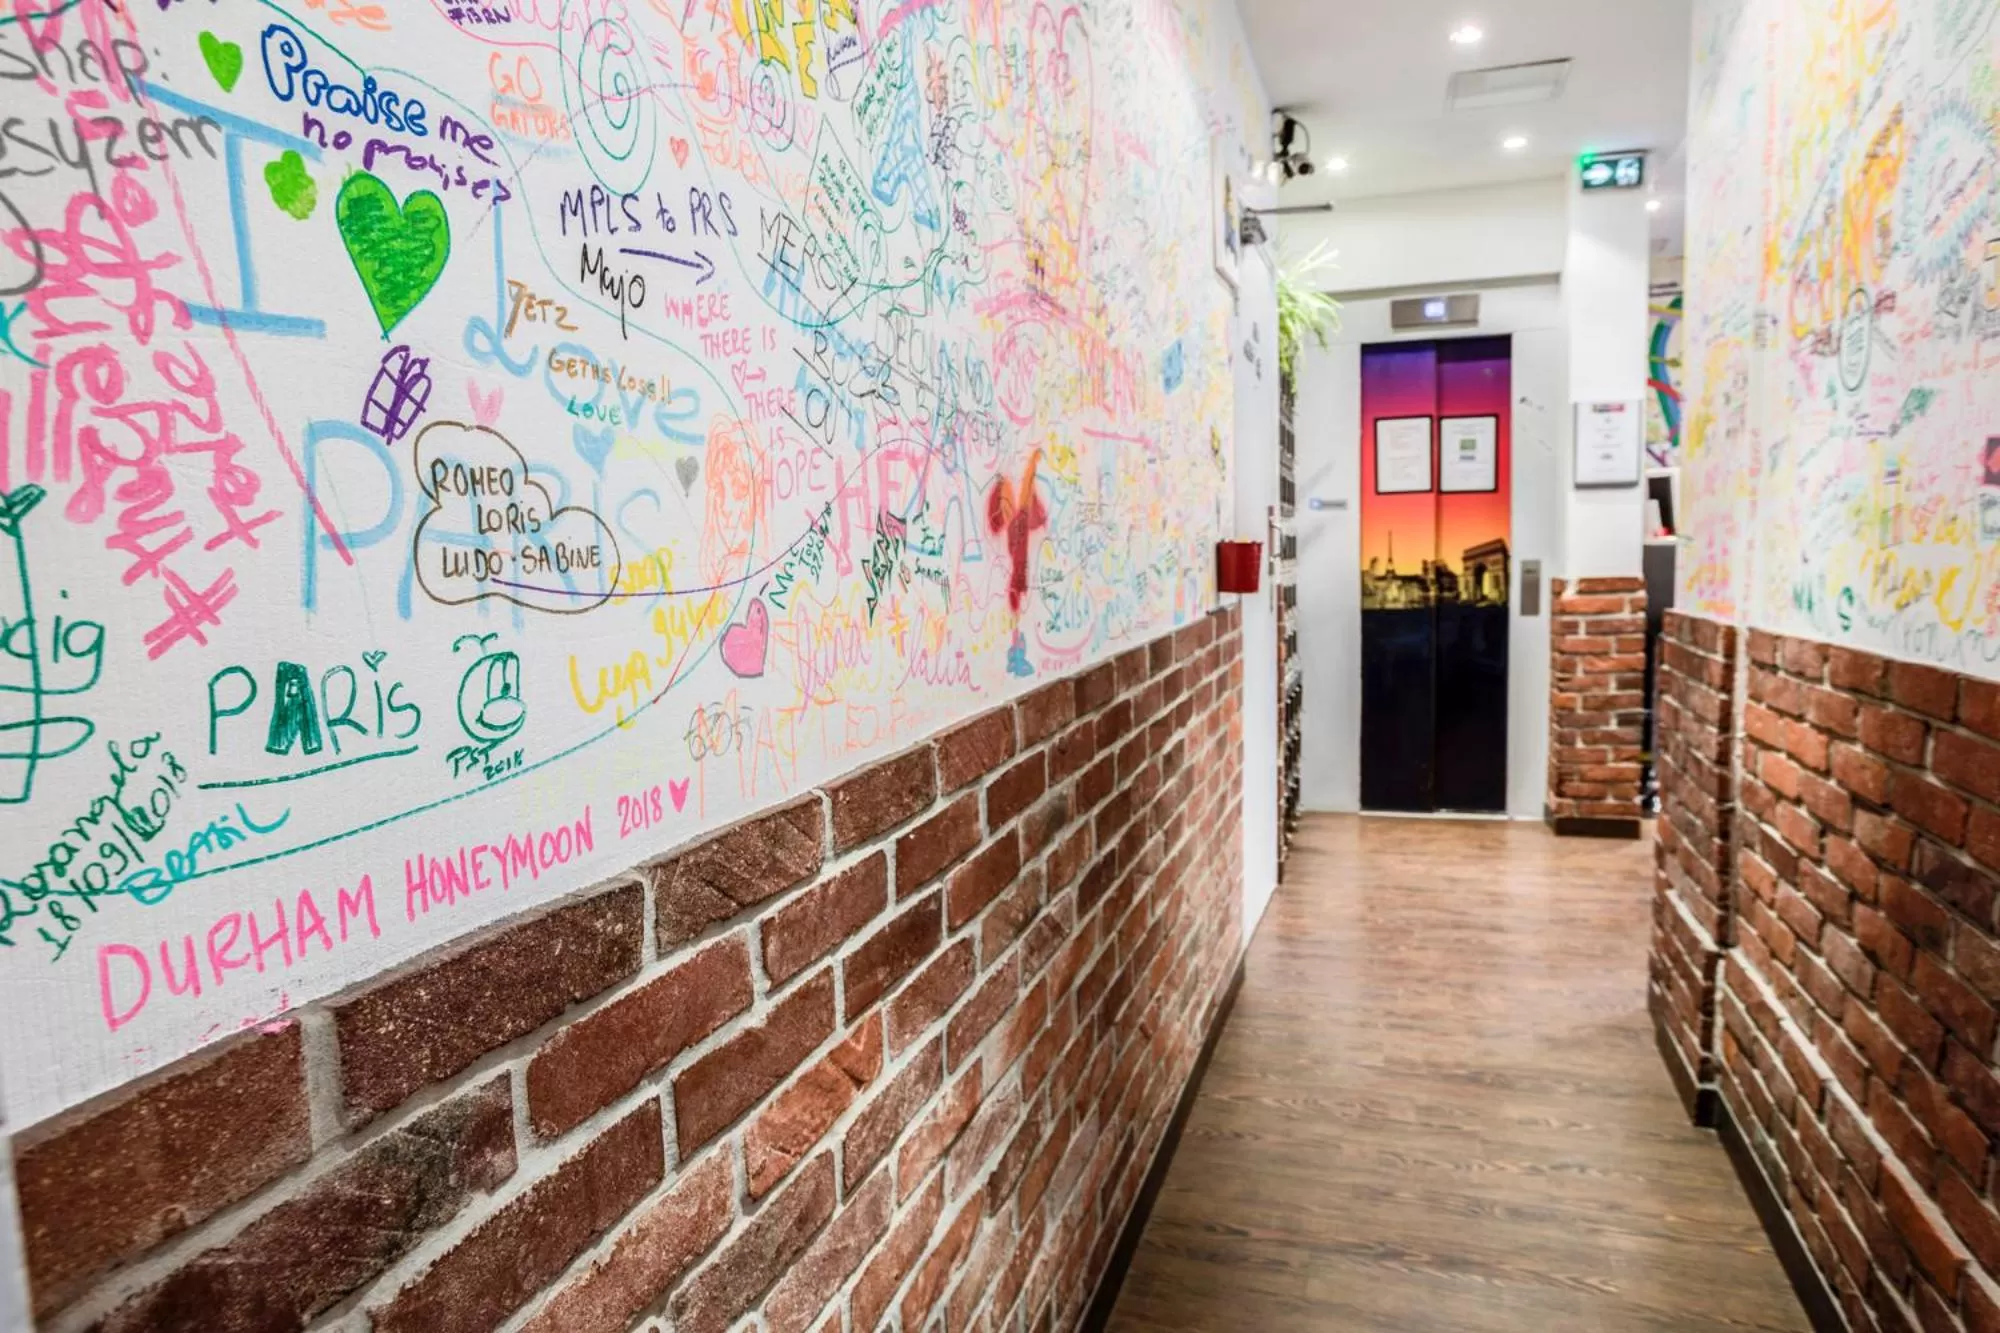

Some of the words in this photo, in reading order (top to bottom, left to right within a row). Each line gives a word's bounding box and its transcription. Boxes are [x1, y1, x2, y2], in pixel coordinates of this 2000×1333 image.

[488, 51, 543, 103] GO
[302, 111, 353, 150] no
[439, 115, 500, 168] me
[559, 185, 642, 237] MPLS
[655, 191, 677, 233] to
[689, 186, 738, 239] PRS
[664, 292, 732, 328] WHERE
[700, 327, 752, 360] THERE
[761, 325, 778, 353] IS
[743, 385, 797, 425] THERE
[429, 457, 514, 498] ROMEO
[442, 547, 504, 582] LUDO
[97, 873, 381, 1032] DURHAM
[404, 804, 595, 923] HONEYMOON
[617, 785, 664, 838] 2018
